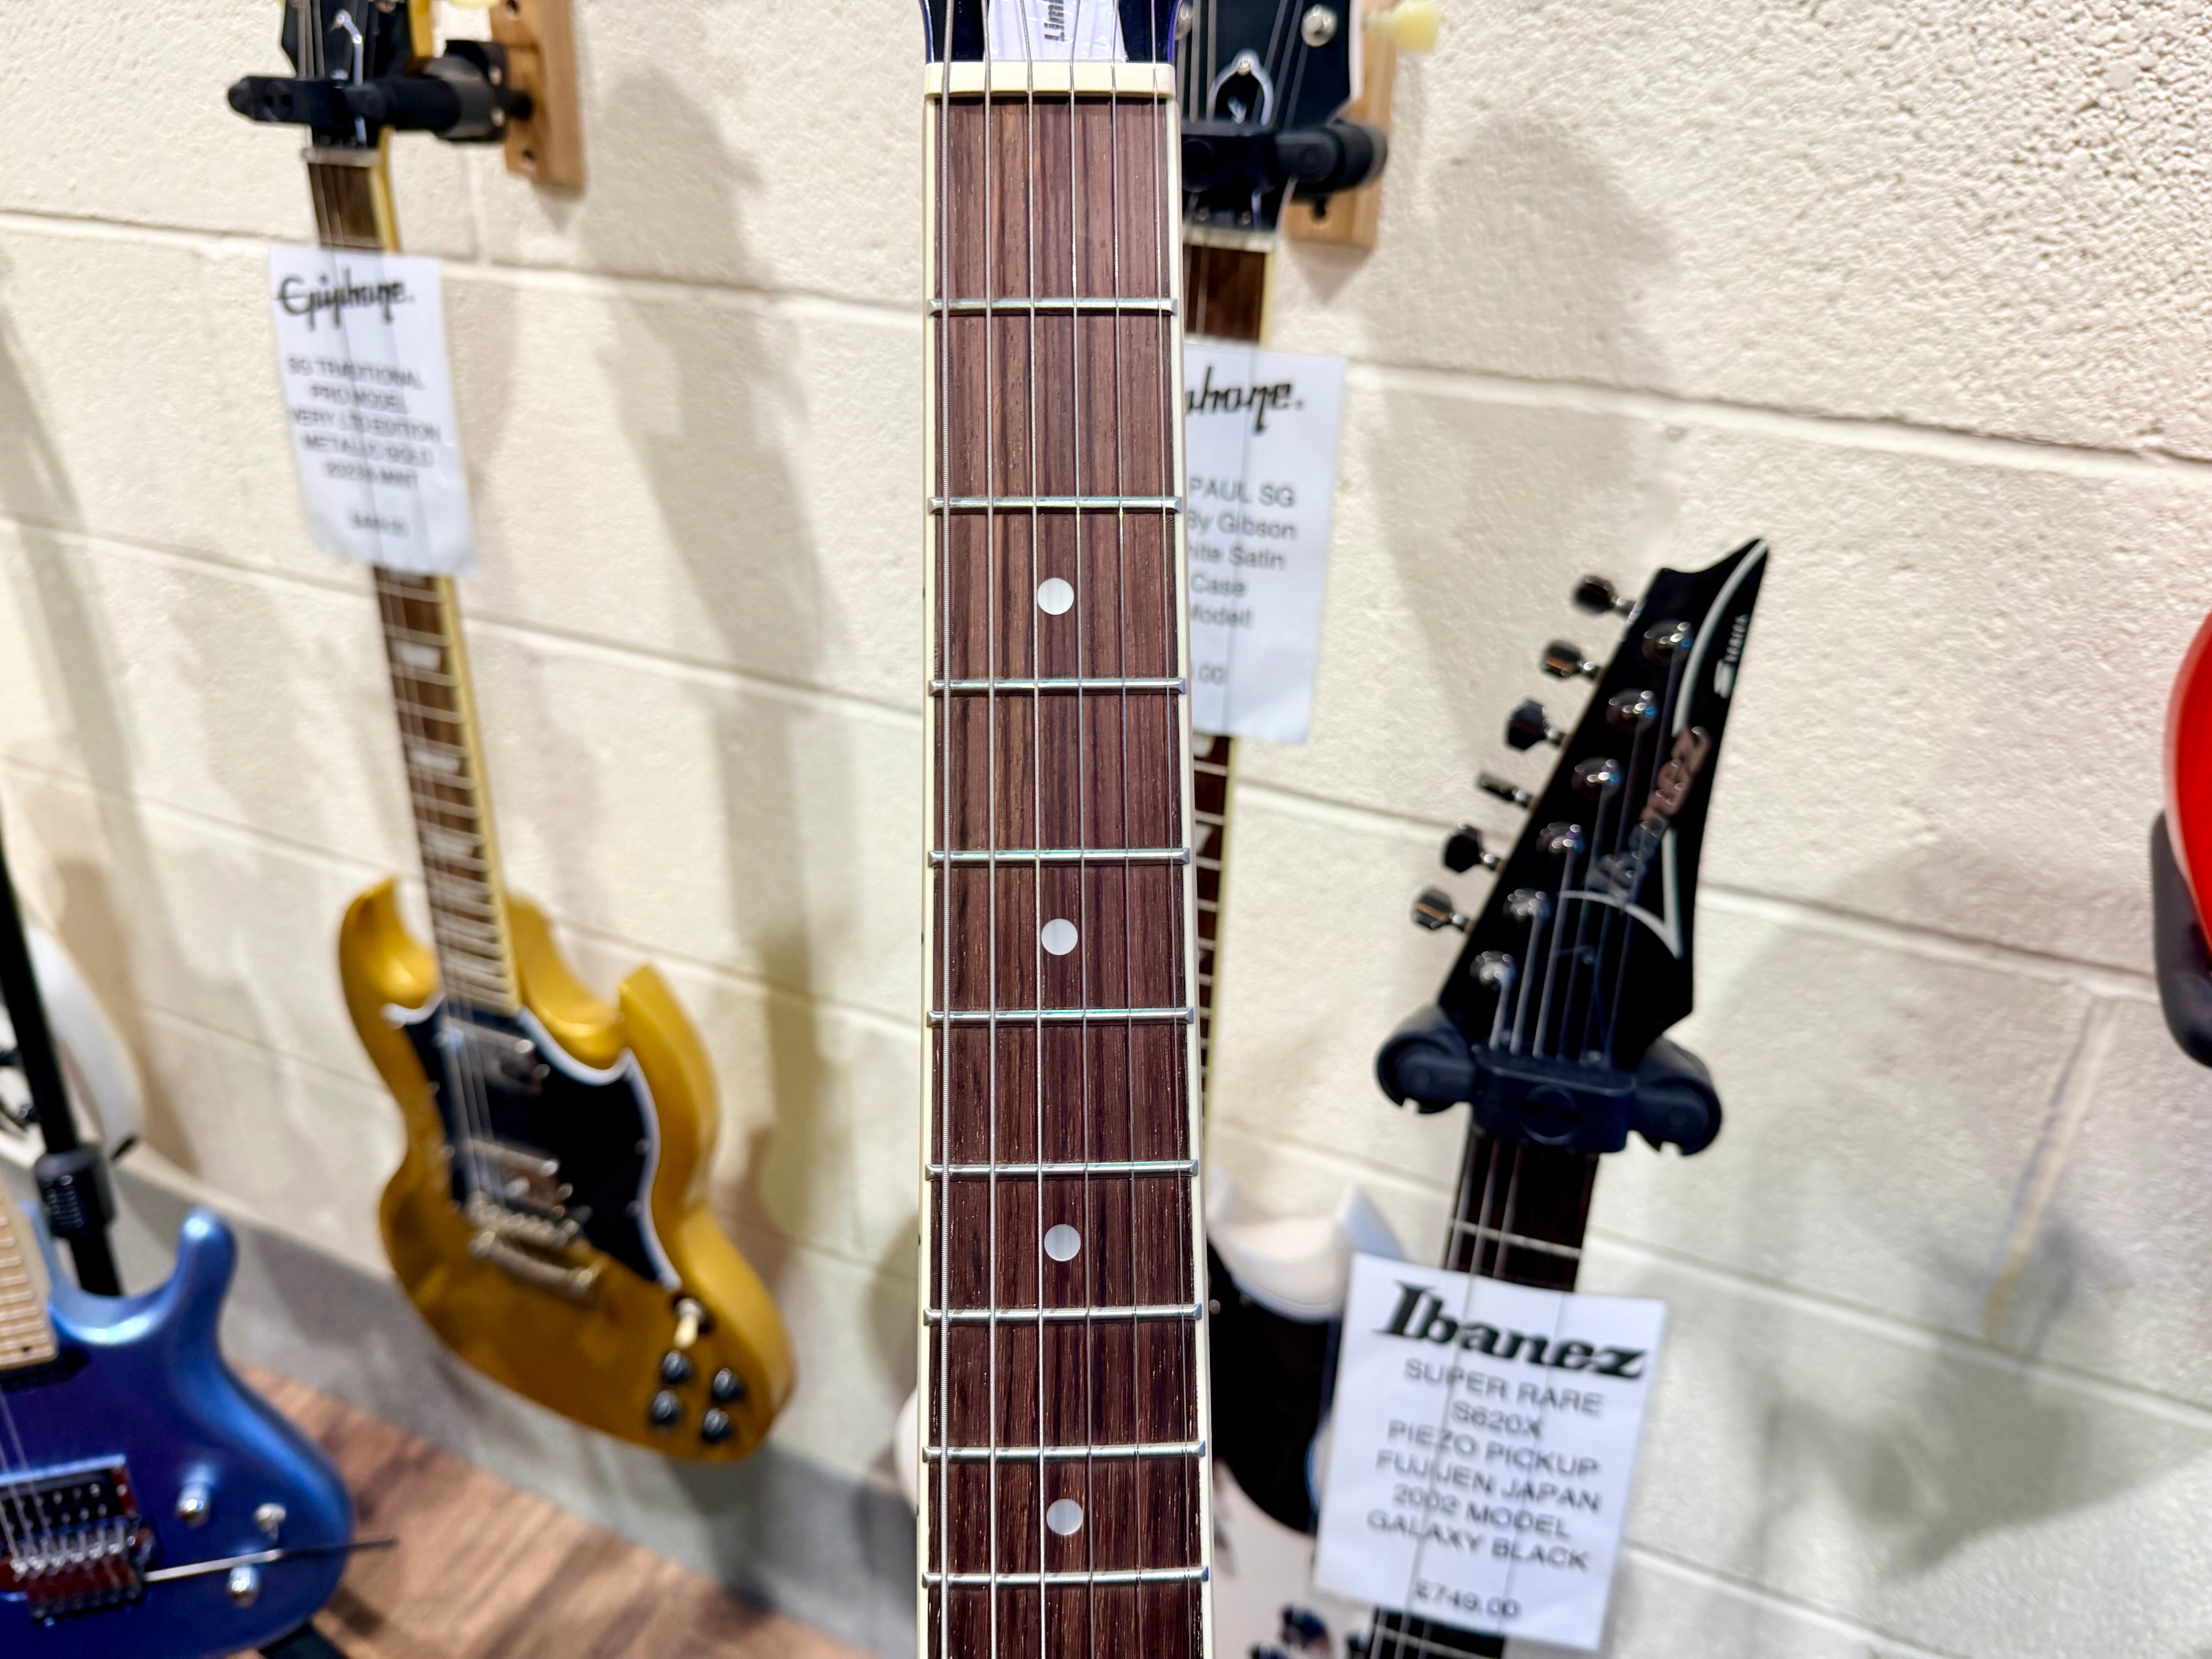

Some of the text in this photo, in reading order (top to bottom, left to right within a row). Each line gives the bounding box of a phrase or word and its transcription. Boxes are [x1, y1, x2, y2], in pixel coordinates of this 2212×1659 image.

[1188, 476, 1296, 508] PAUL SG
[1217, 510, 1298, 540] Gibson
[1228, 546, 1286, 571] Satin
[1190, 572, 1247, 597] Case
[1372, 1279, 1648, 1381] Ibanez
[1405, 1358, 1605, 1417] SUPER RARE
[1451, 1400, 1543, 1440] S620X
[1388, 1419, 1600, 1479] PIEZO PICKUP
[1394, 1483, 1571, 1539] 2002 MODEL
[1500, 1482, 1601, 1513] JAPAN
[1367, 1509, 1589, 1573] GALAXY BLACK
[1415, 1578, 1521, 1618] £749.00
